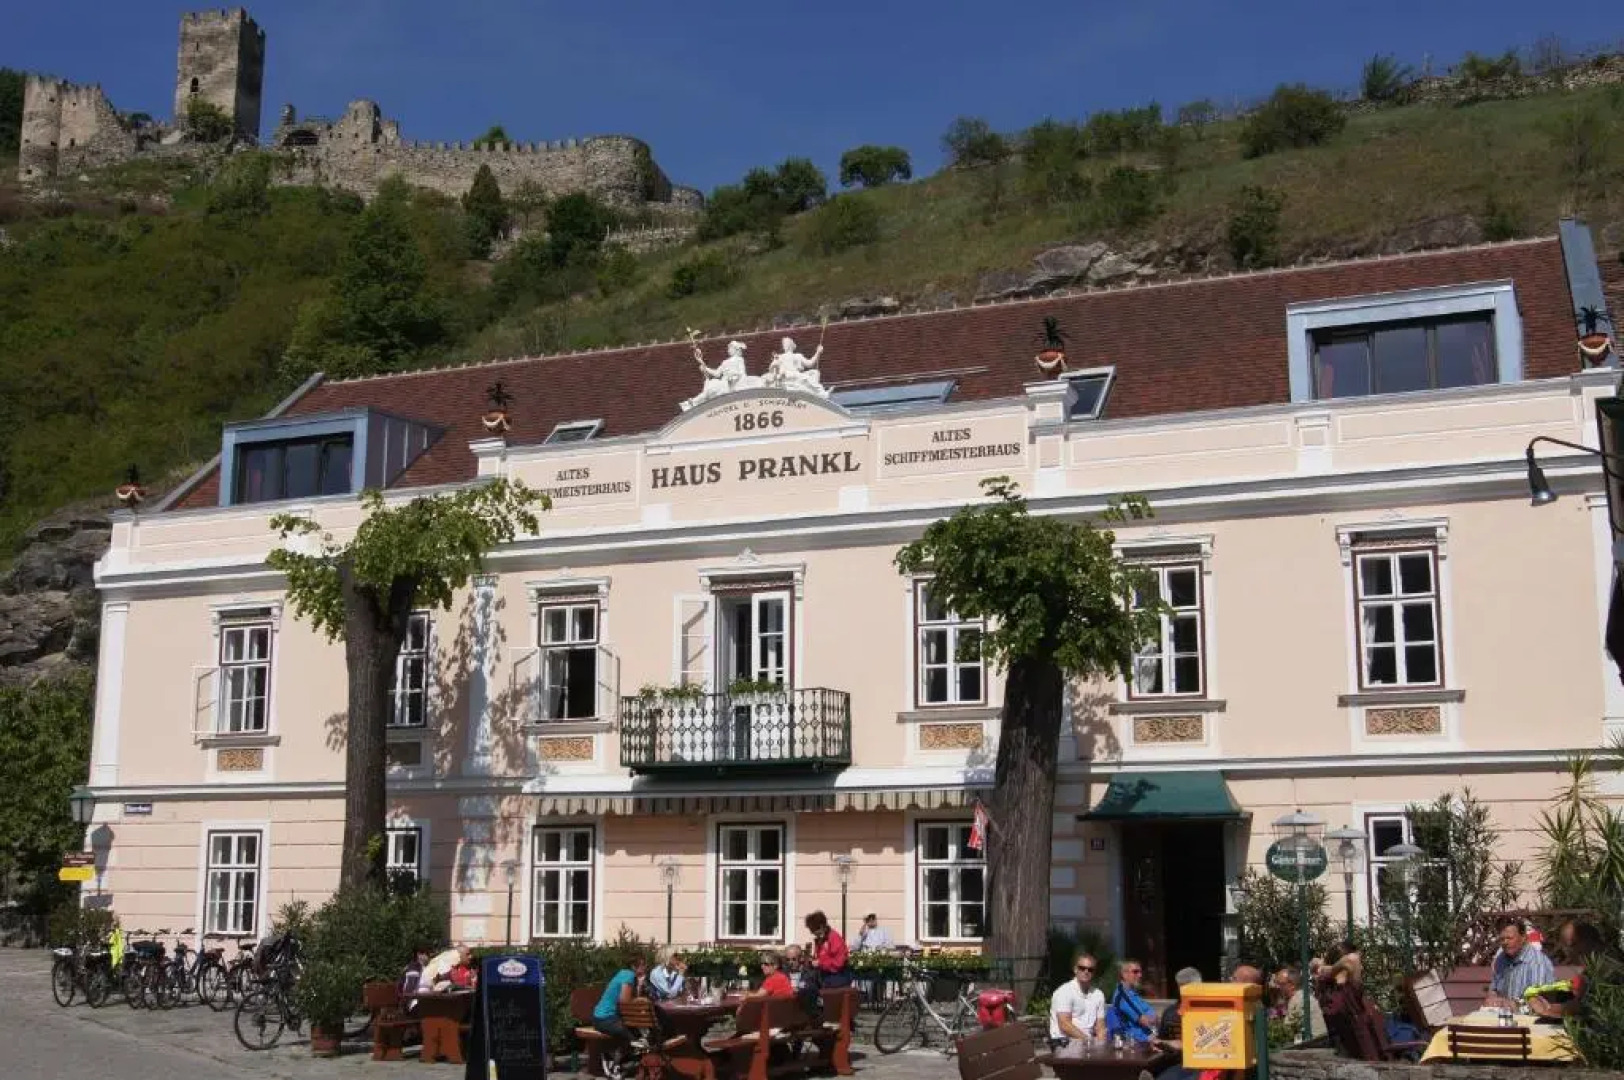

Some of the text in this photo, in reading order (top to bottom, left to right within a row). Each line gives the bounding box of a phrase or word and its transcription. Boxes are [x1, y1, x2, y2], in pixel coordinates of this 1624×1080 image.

[734, 410, 785, 432] 1866
[932, 428, 972, 443] ALTES
[884, 442, 1021, 466] SCHIFFMEISTERHAUS
[556, 467, 590, 481] ALTES
[651, 451, 861, 489] HAUS PRANKL
